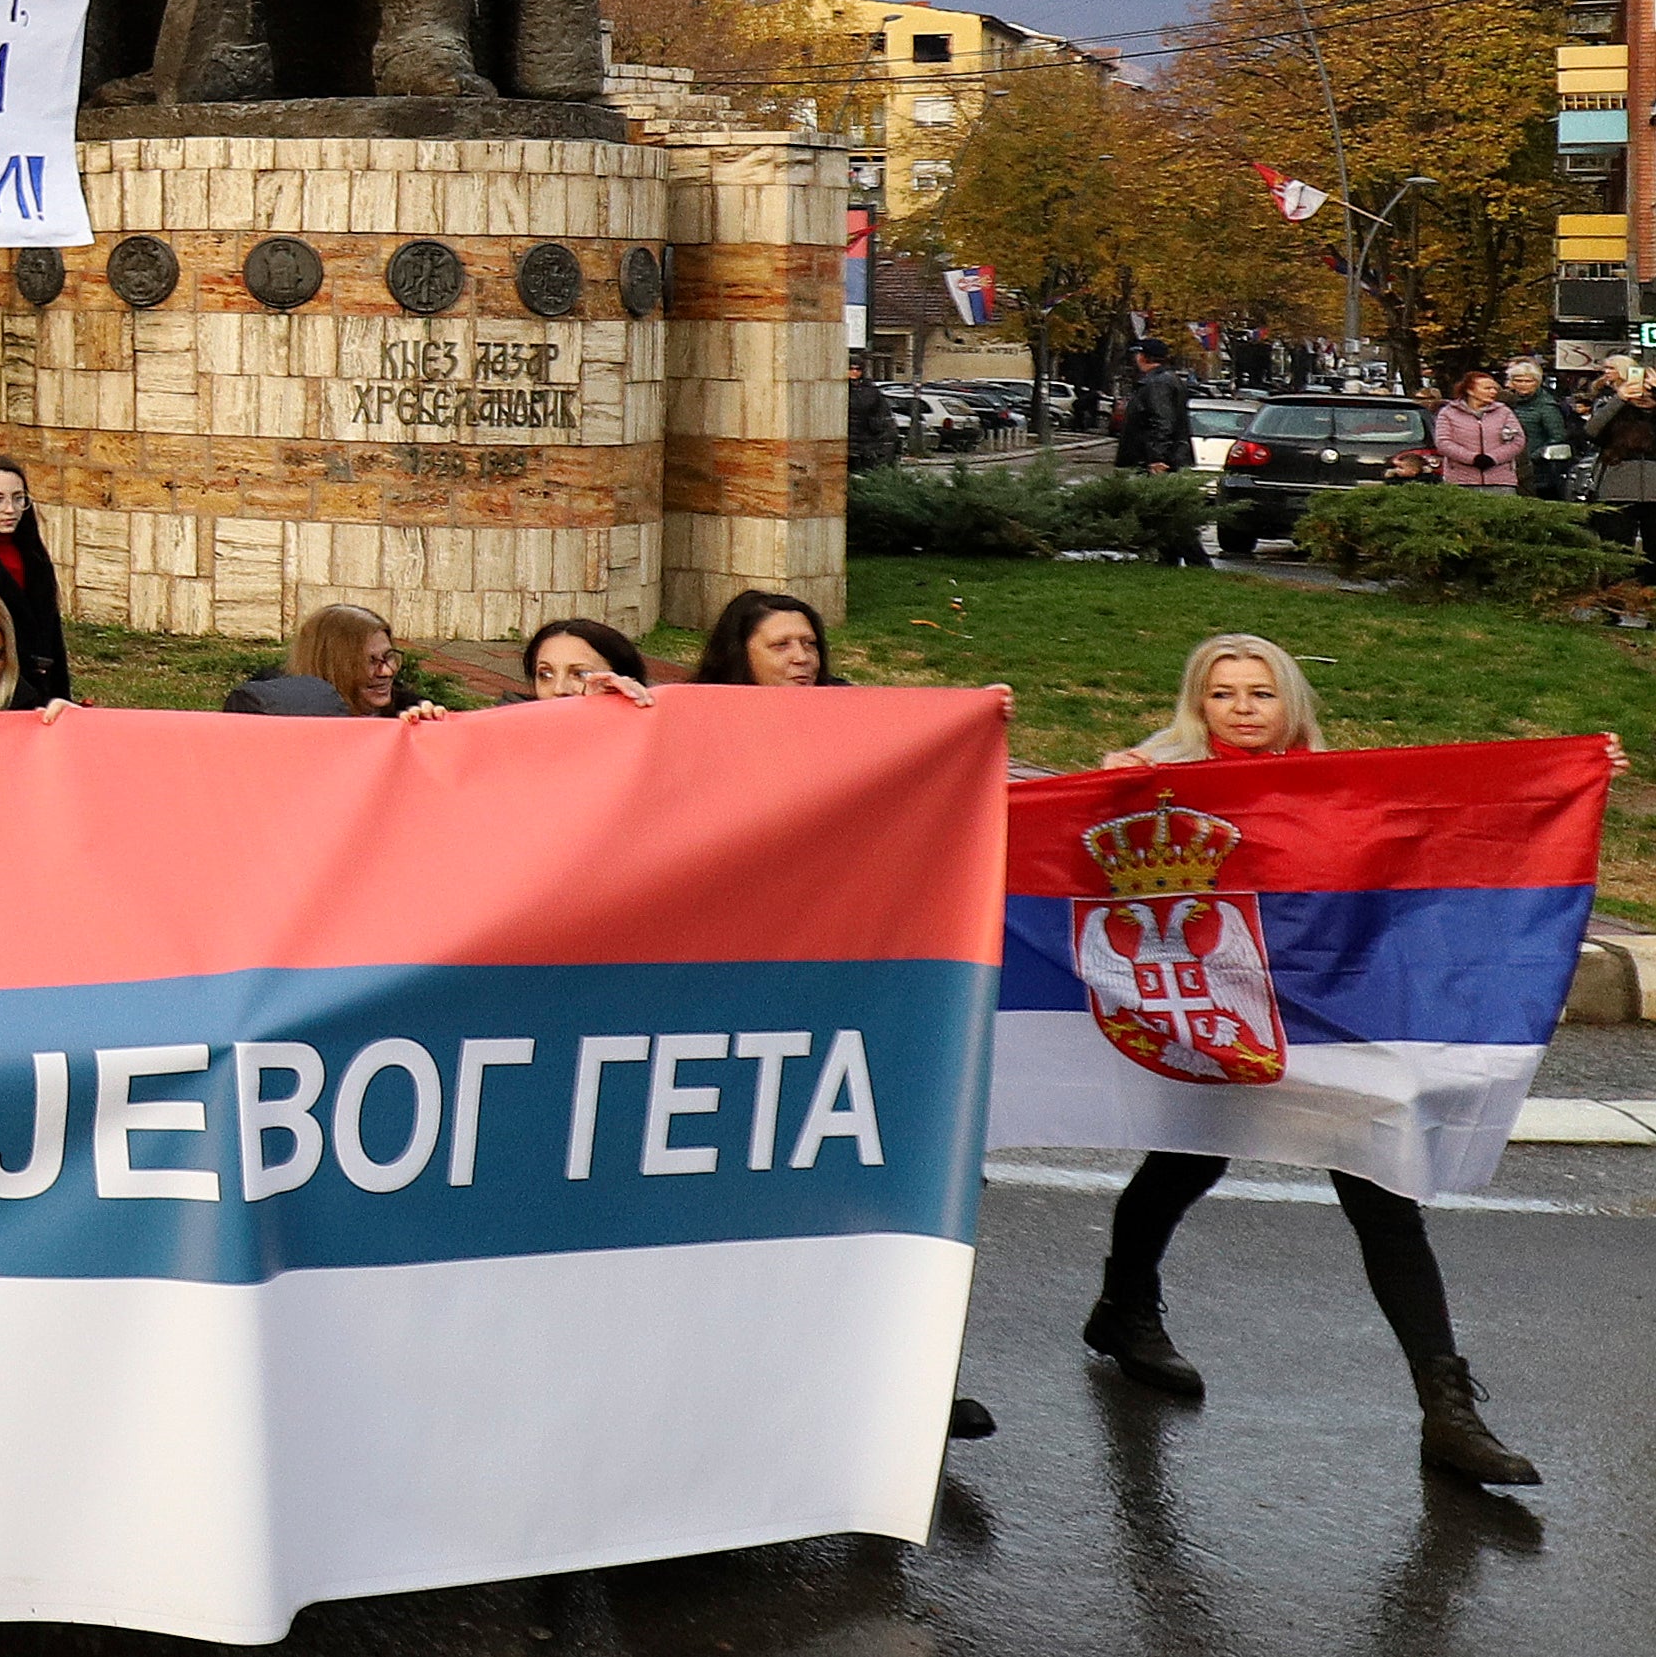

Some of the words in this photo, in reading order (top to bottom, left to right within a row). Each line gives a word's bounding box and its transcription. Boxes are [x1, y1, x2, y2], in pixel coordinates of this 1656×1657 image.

[380, 340, 459, 381] КНЕЗ
[473, 342, 559, 382] ЛАЗАР
[564, 1029, 886, 1182] ГЕТА
